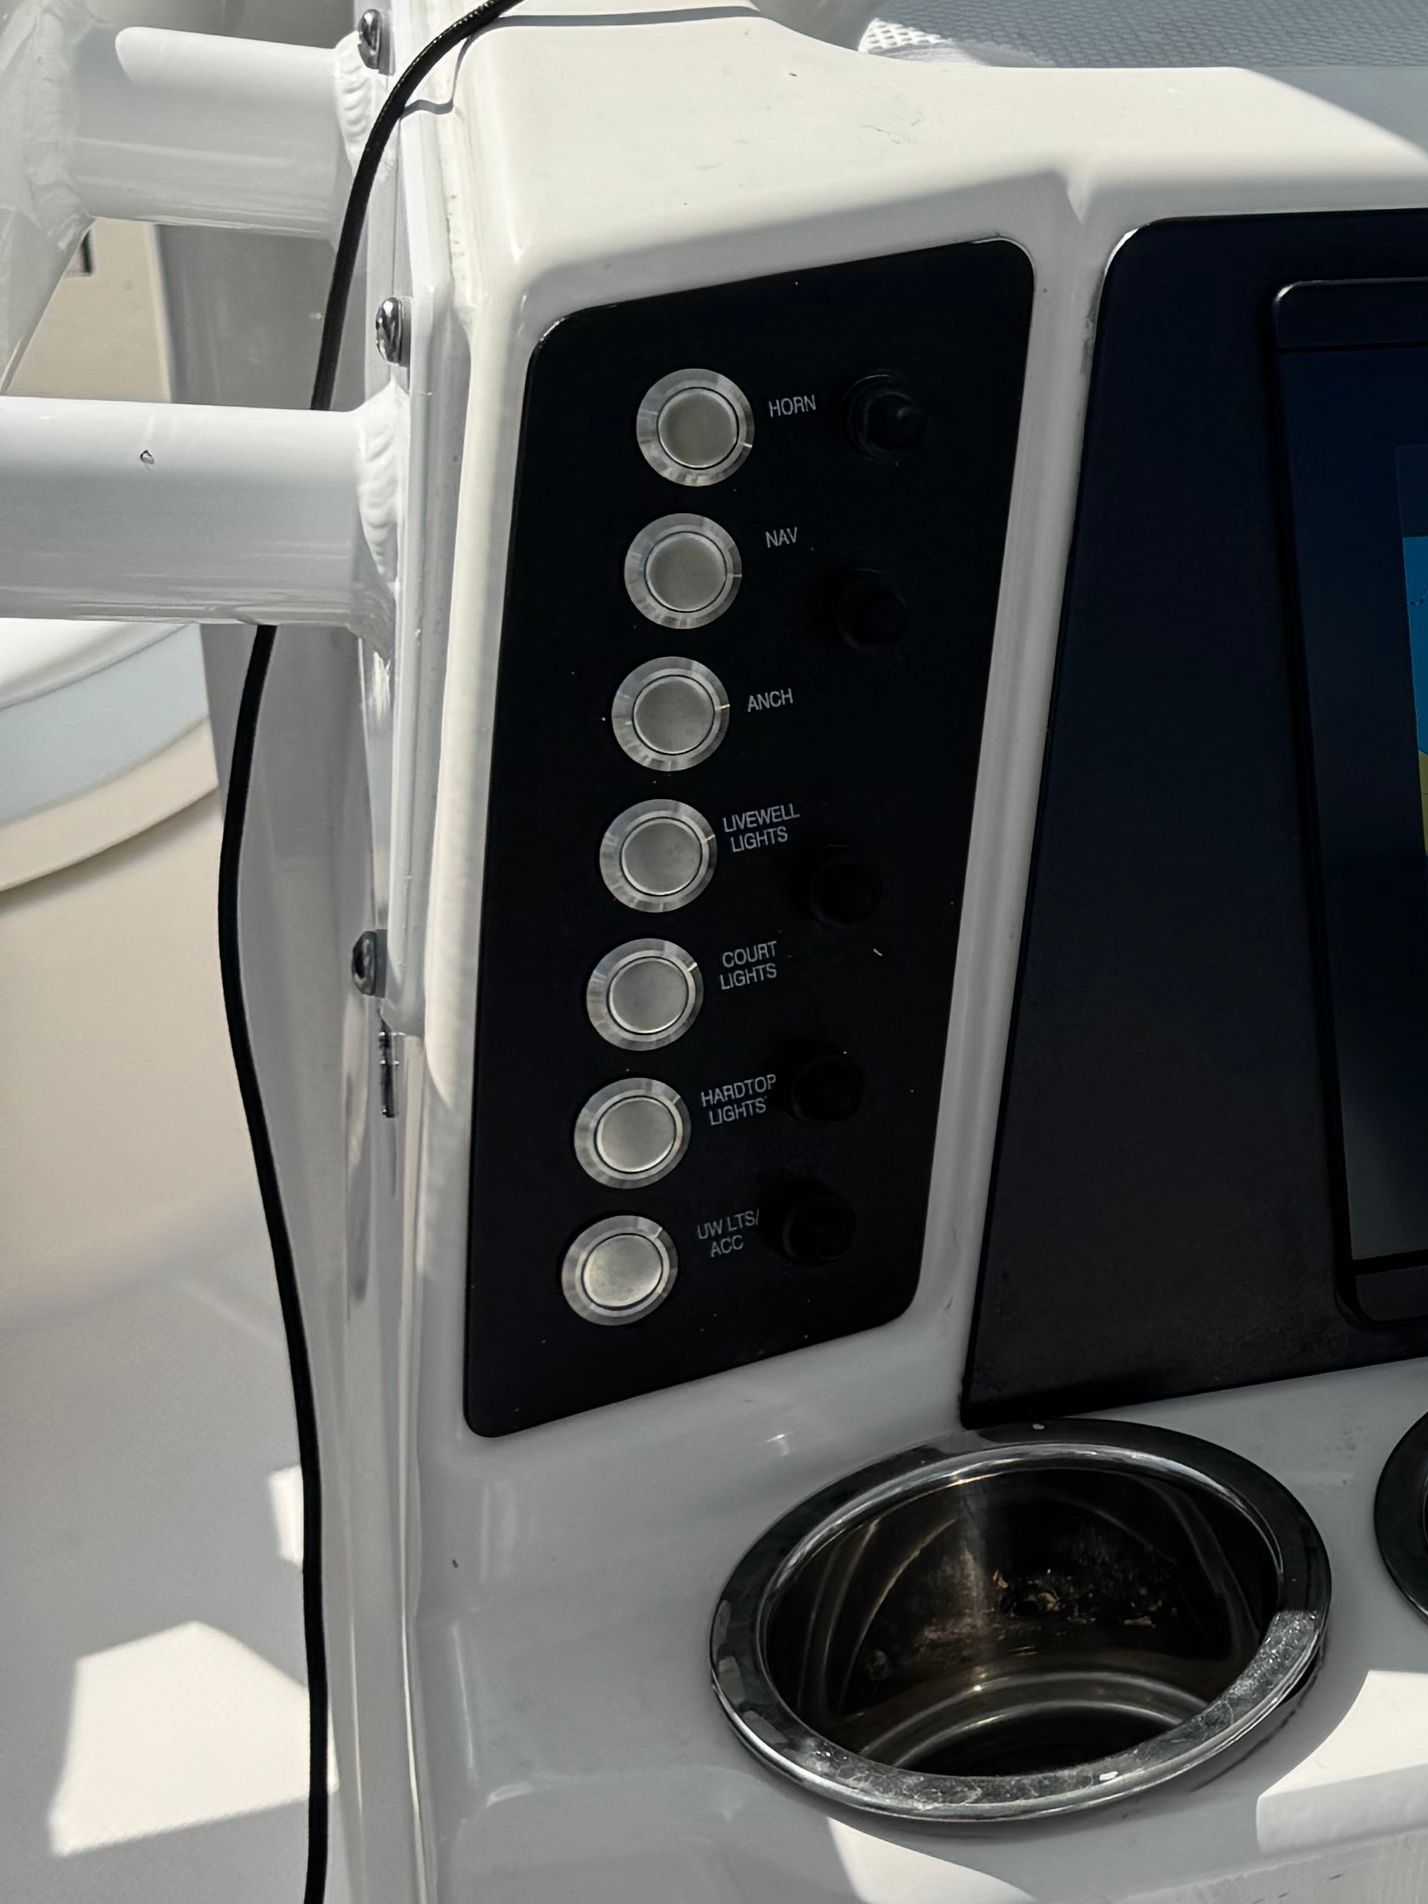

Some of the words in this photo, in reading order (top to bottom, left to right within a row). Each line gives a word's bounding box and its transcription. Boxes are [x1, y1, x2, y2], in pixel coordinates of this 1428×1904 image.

[768, 395, 817, 418] HORN
[765, 527, 799, 549] NAV
[747, 688, 794, 713] ANCH
[722, 803, 801, 833] LIVEWELL
[730, 826, 789, 853] LIGHTS
[721, 941, 778, 970] COURT
[719, 963, 778, 991] LIGHTS
[701, 1074, 777, 1109] HARDTOP
[709, 1098, 767, 1127] LIGHTS
[697, 1217, 724, 1242] UW
[726, 1208, 760, 1236] LTS/
[710, 1234, 744, 1259] ACC
